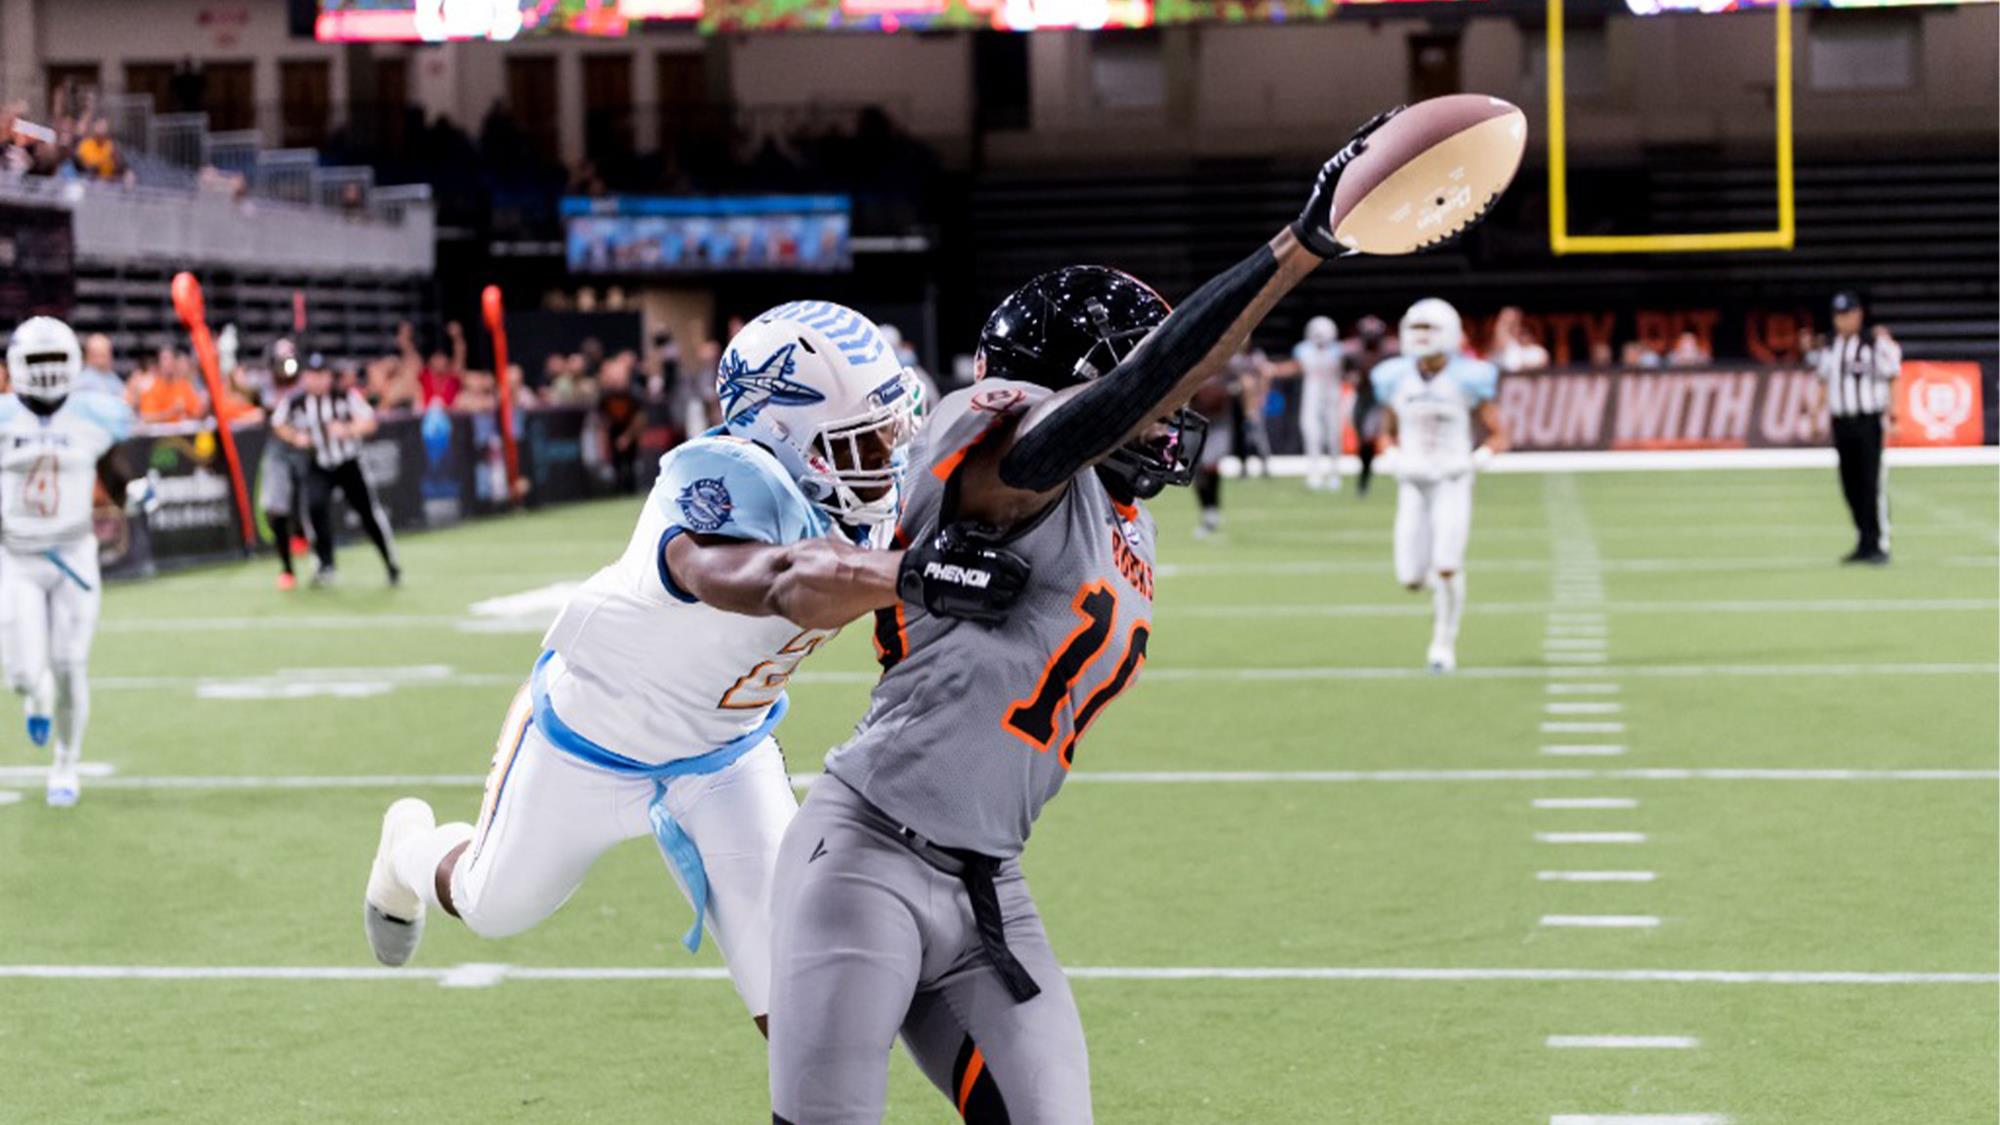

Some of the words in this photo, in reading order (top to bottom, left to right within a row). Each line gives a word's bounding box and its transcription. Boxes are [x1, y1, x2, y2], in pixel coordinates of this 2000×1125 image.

[1500, 376, 1608, 445] RUN
[1613, 373, 1757, 440] WITH
[24, 453, 60, 518] 4
[1000, 577, 1151, 771] 10
